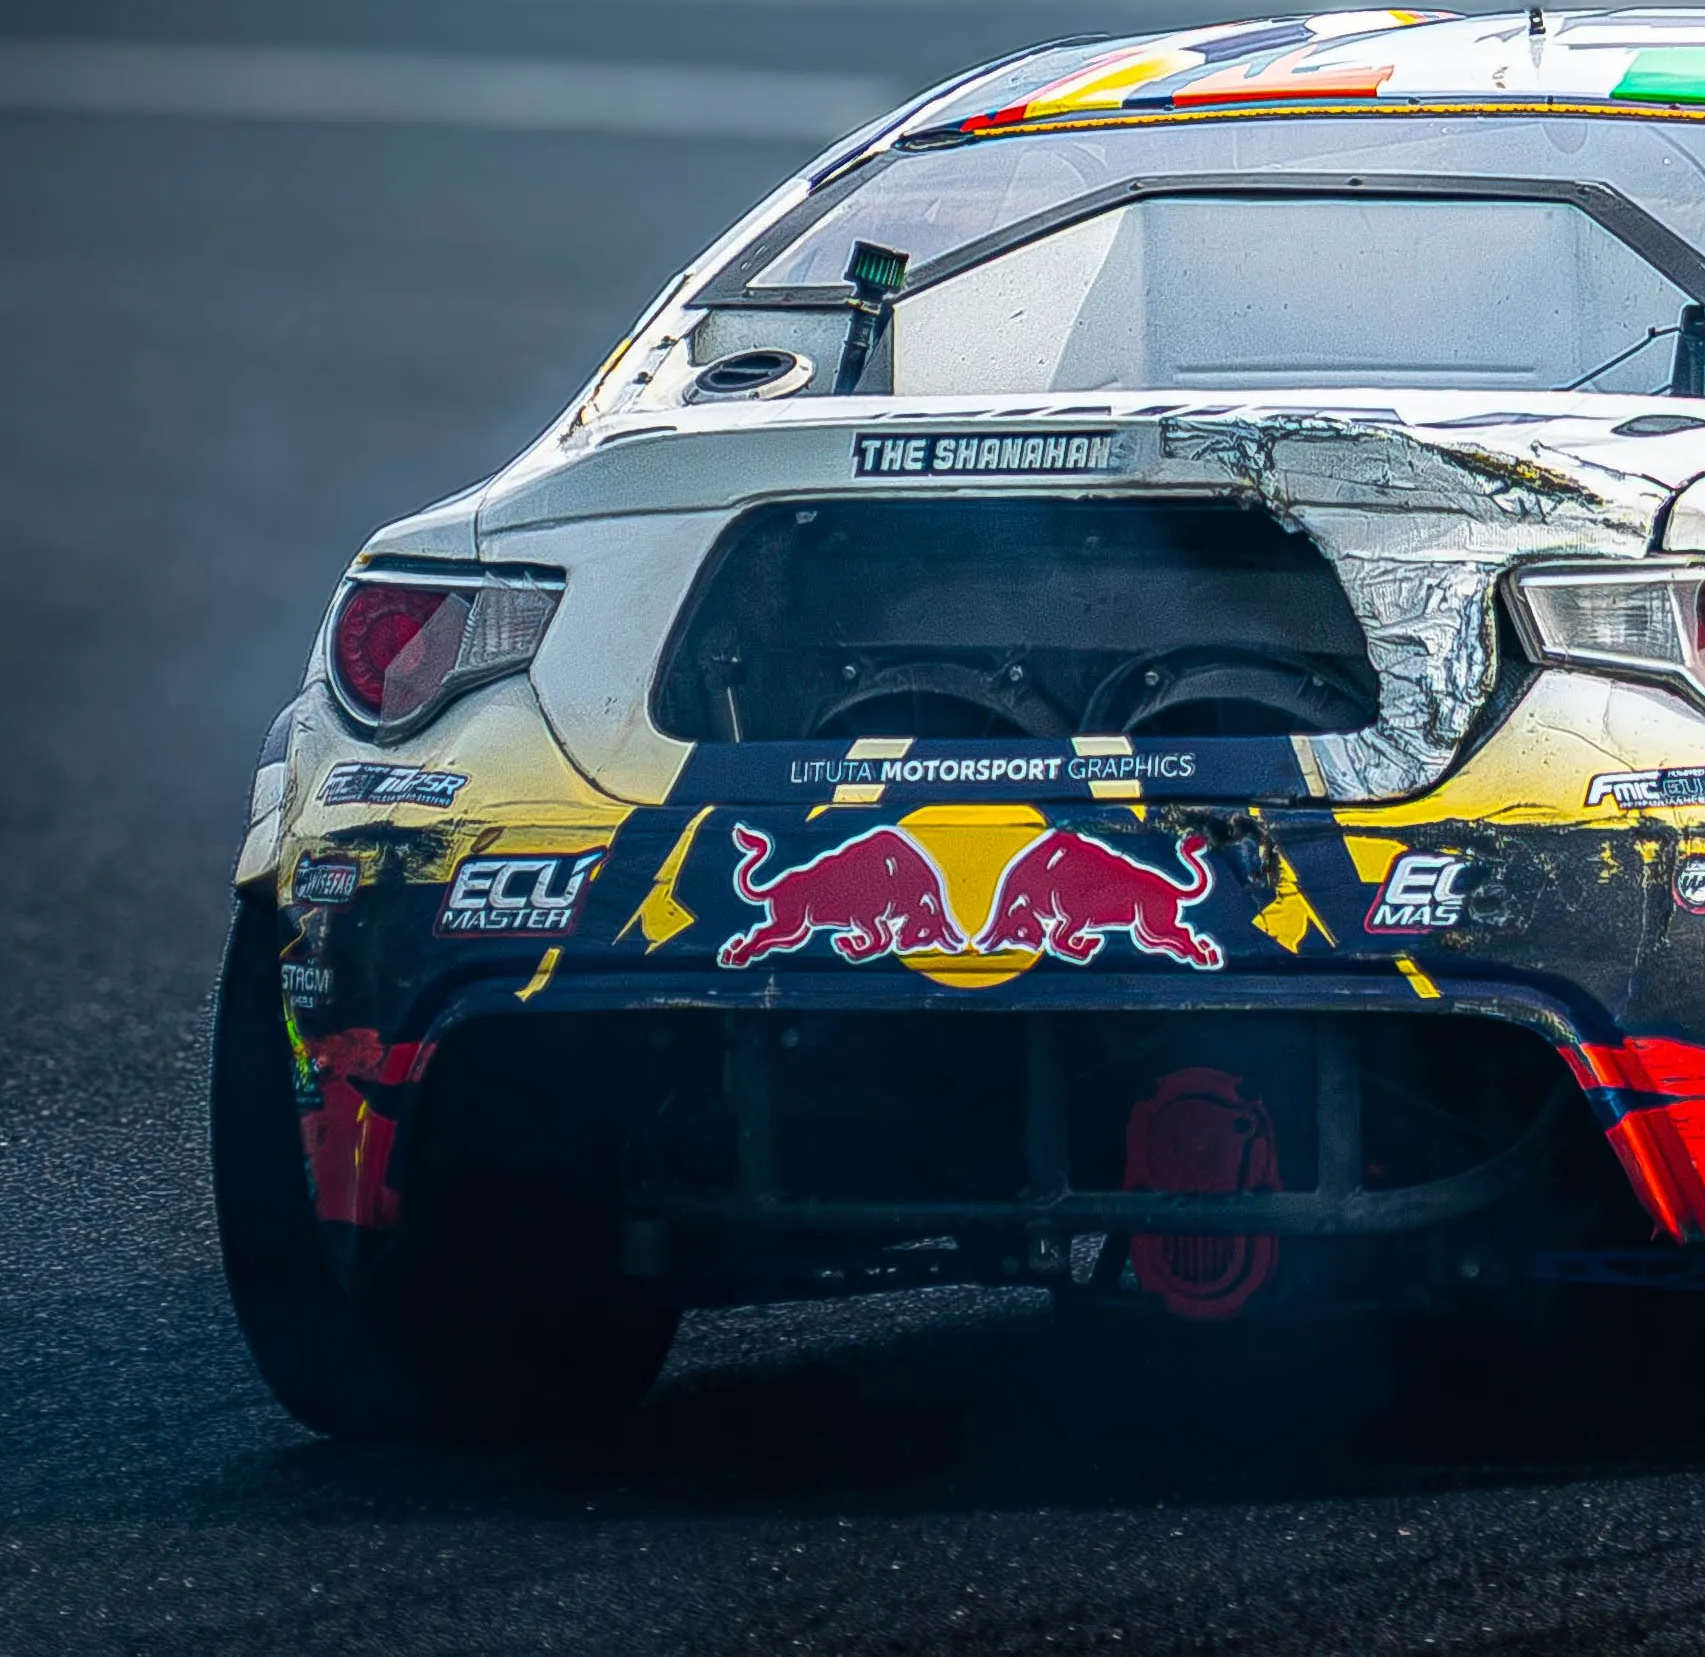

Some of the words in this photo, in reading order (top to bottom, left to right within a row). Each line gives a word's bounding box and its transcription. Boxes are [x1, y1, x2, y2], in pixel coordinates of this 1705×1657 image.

[861, 440, 926, 470] THE
[933, 437, 1116, 469] SHANAHAN
[791, 759, 875, 783] LITUTA
[881, 757, 1062, 781] MOTORSPORT
[1067, 753, 1196, 779] GRAPHICS
[450, 851, 605, 909] ECU
[1385, 856, 1470, 904] EC
[442, 909, 571, 928] MASTER
[1373, 905, 1461, 925] MAS
